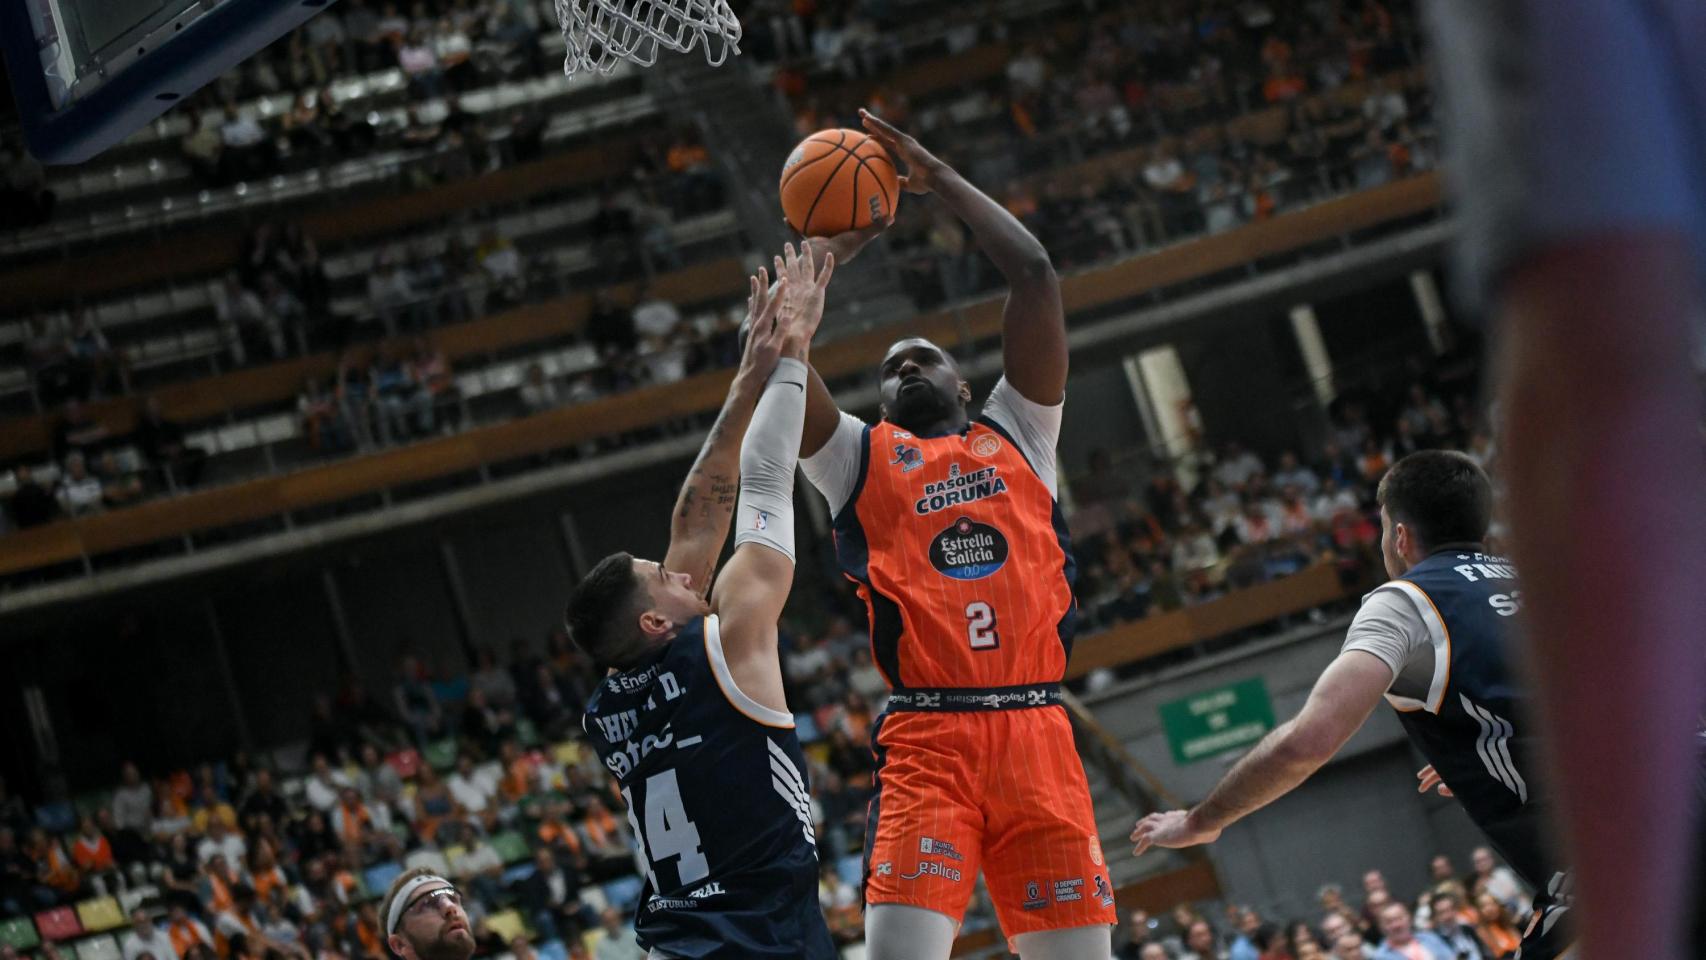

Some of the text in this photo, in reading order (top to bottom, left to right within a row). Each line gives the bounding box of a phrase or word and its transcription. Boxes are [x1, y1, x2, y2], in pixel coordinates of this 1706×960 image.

[925, 466, 996, 496] BASQUET
[941, 533, 994, 552] Estrella
[945, 547, 994, 565] Galicia
[965, 601, 999, 651] 2
[658, 671, 687, 702] D.
[900, 861, 961, 882] galicia
